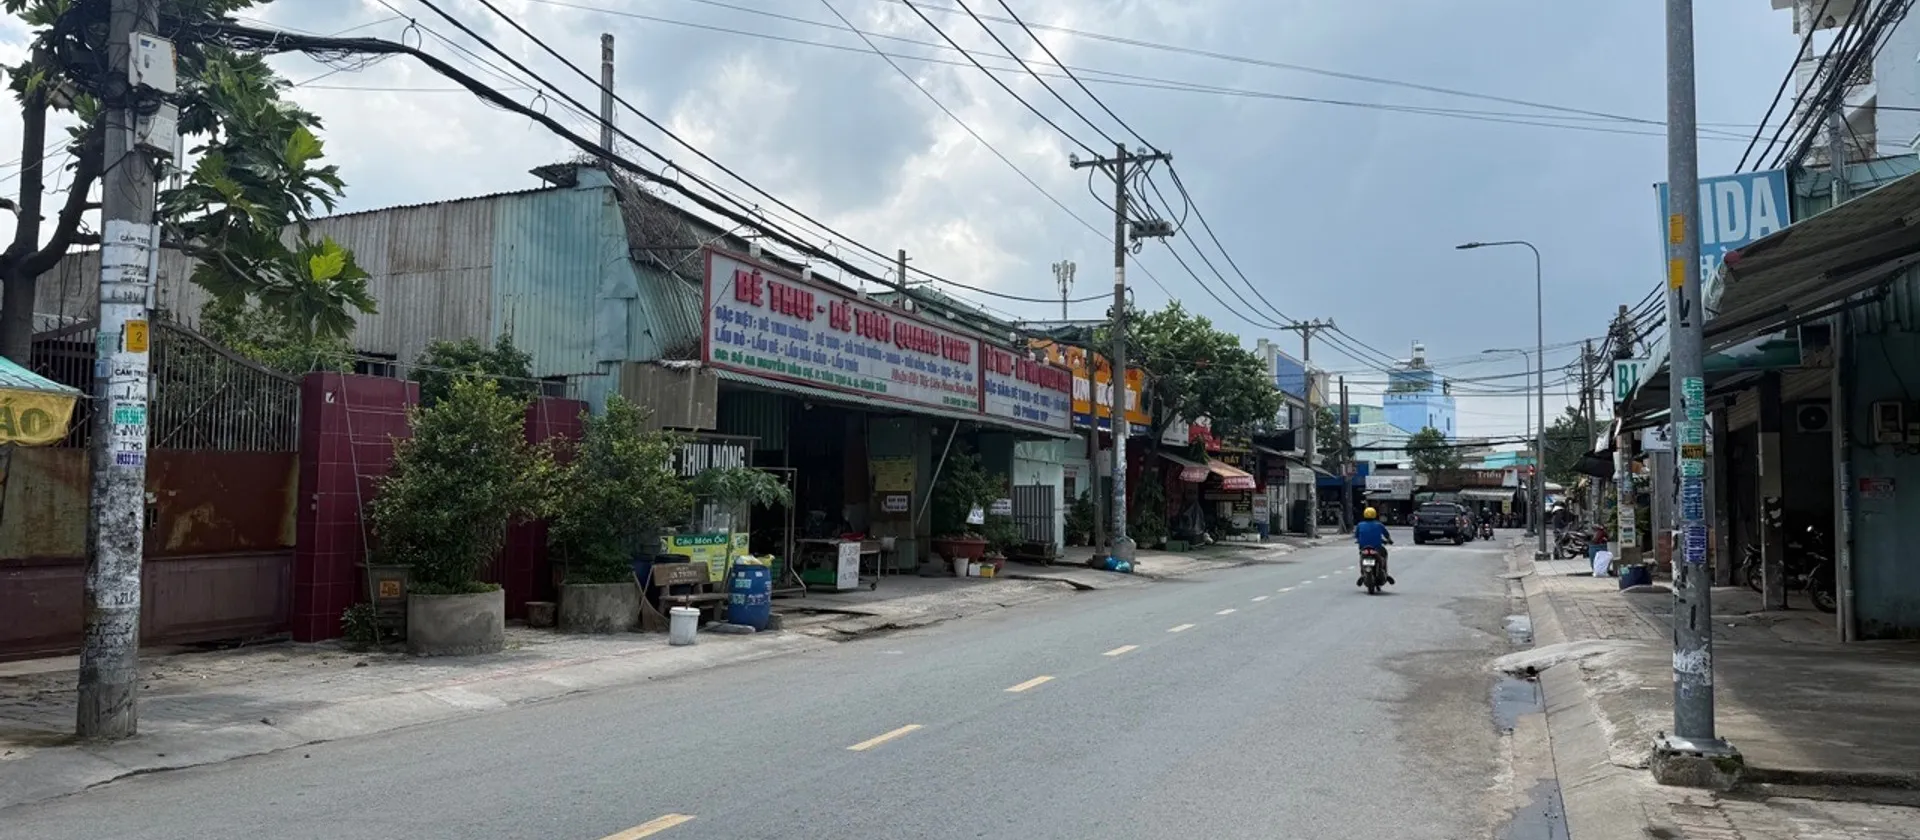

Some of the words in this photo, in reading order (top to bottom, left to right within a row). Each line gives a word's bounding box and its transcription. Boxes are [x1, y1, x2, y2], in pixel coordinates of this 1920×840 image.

[136, 331, 143, 343] 2
[767, 280, 815, 322] THUI
[894, 321, 940, 357] QUANG
[940, 335, 972, 366] VINH
